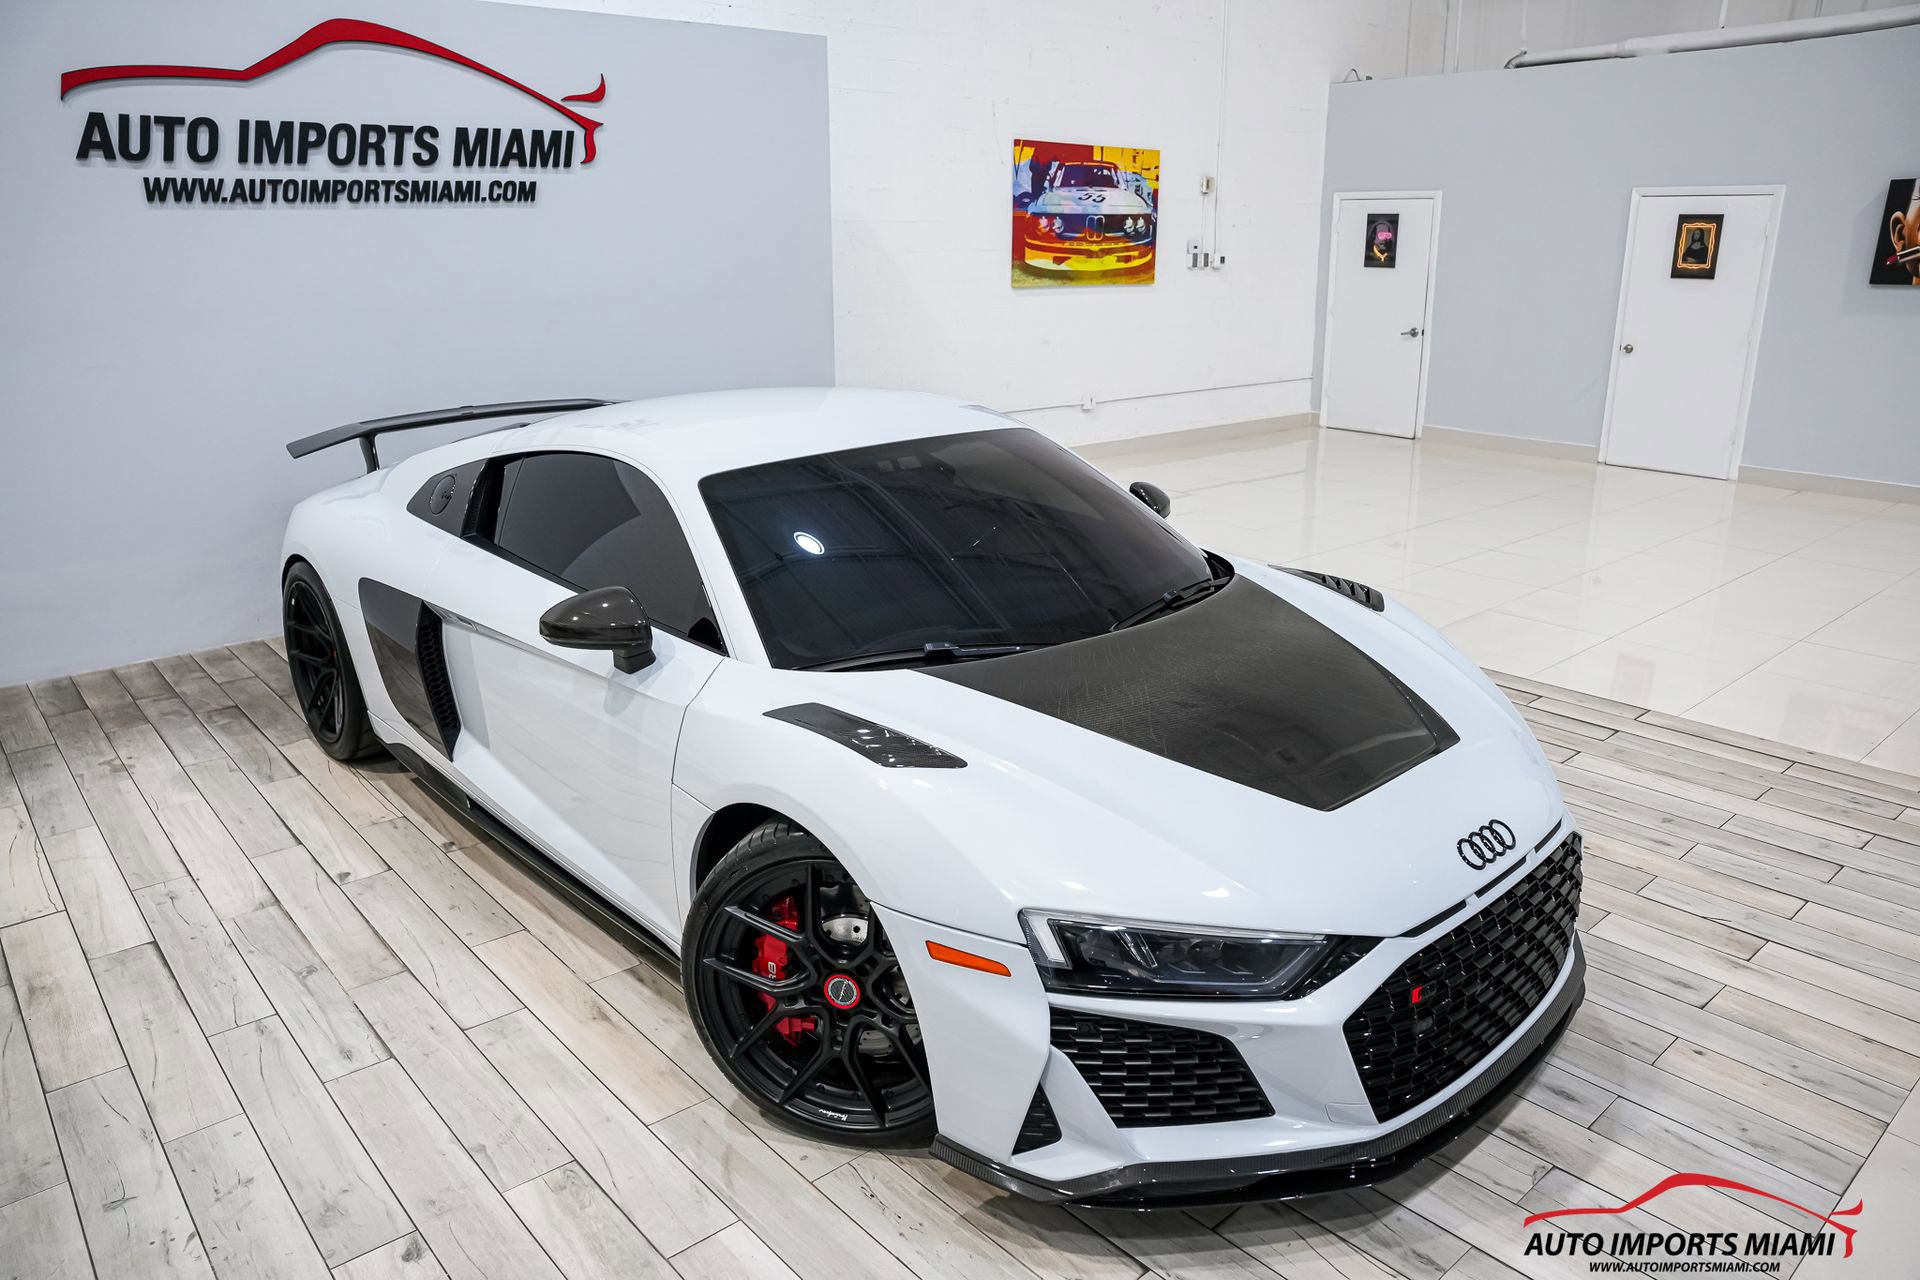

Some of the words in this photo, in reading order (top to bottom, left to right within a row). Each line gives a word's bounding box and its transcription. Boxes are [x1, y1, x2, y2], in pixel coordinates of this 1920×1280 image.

[76, 111, 219, 164] AUTO
[237, 119, 440, 168] IMPORTS
[452, 127, 575, 169] MIAMI
[142, 176, 538, 204] WWW.AUTOIMPORTSMIAMI.COM
